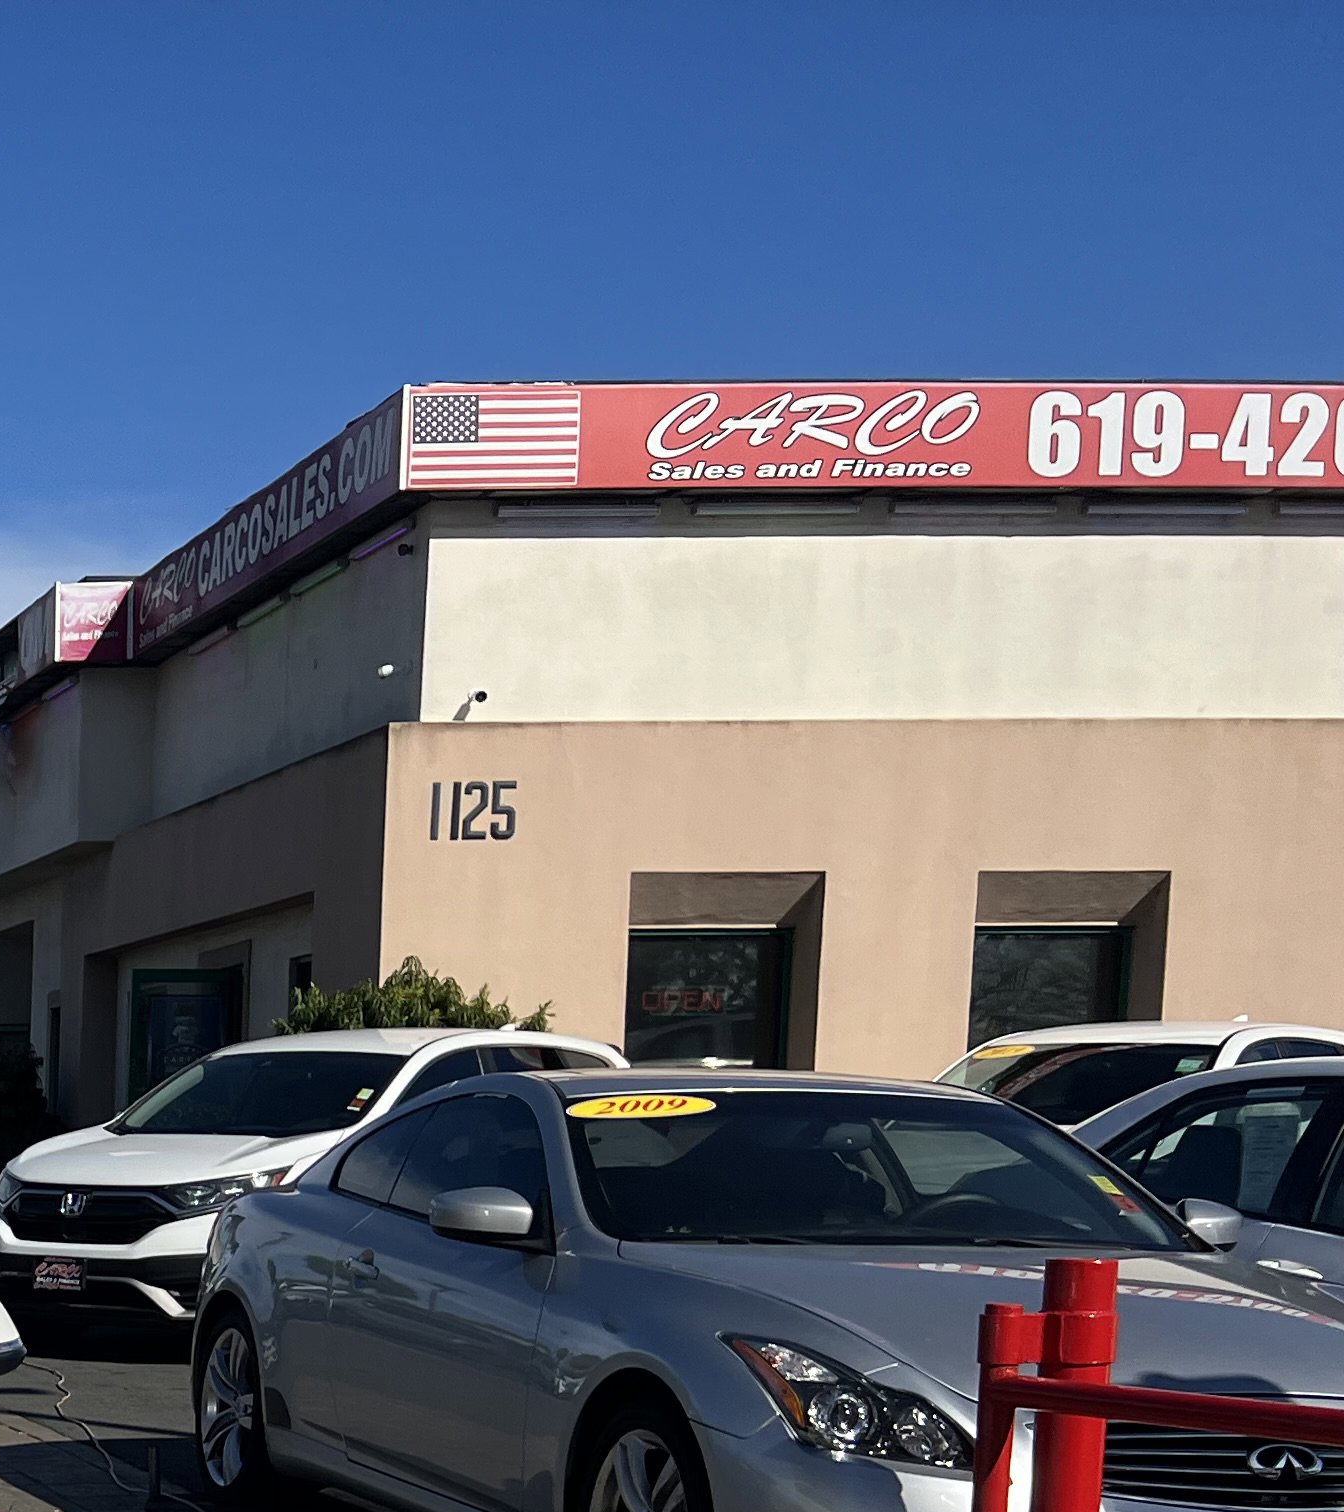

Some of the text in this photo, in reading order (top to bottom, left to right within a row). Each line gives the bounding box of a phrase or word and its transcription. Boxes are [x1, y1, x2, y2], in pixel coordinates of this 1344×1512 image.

[646, 389, 1344, 478] CARCO 619-42
[647, 458, 973, 481] Sales and Finance
[197, 406, 397, 600] CARCOSALES.COM
[429, 780, 518, 841] 1125
[641, 990, 723, 1012] OPEN
[593, 1098, 688, 1116] 2009
